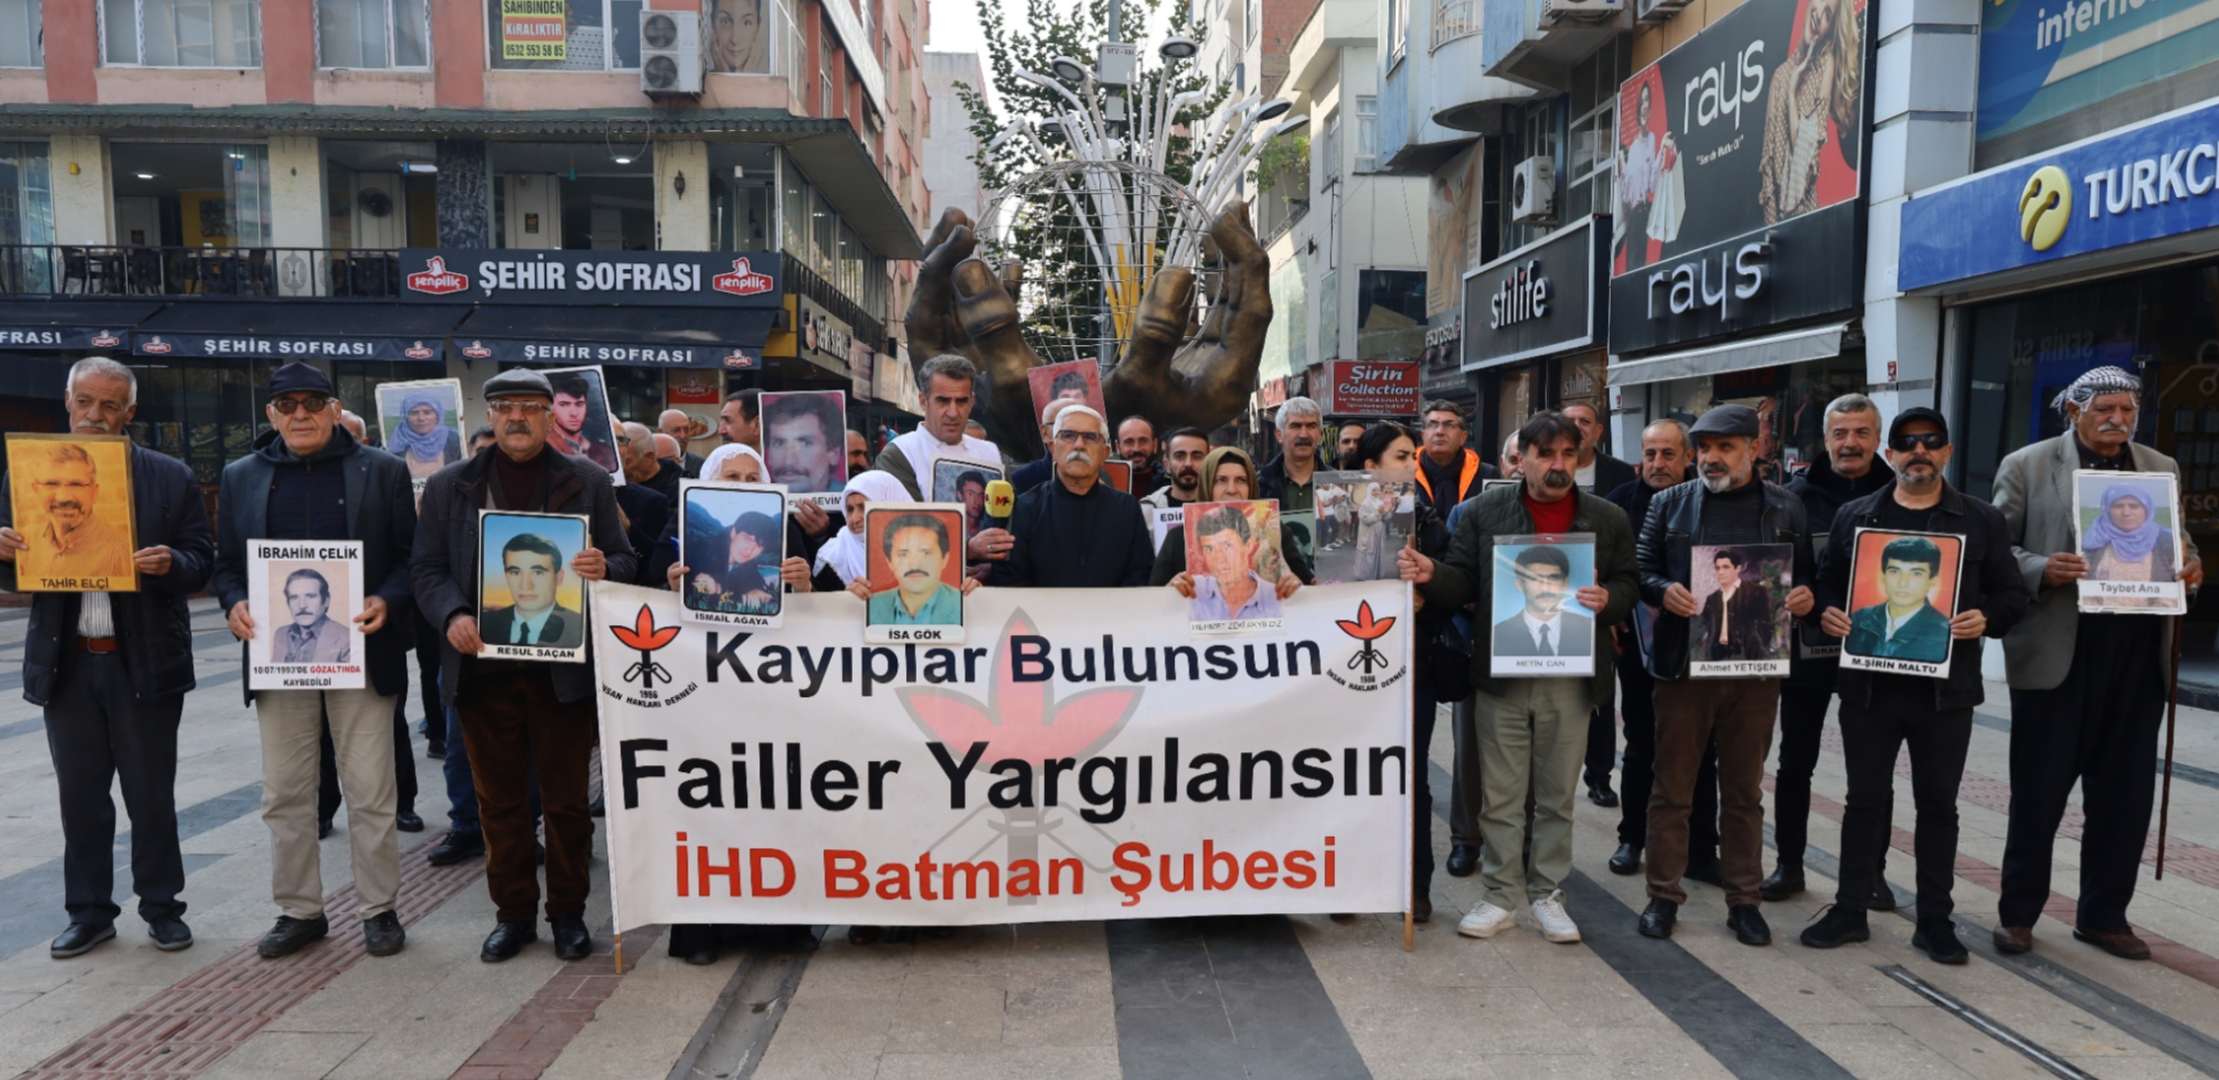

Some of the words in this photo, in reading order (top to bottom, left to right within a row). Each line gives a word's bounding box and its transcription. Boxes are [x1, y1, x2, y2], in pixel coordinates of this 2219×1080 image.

[506, 44, 524, 56] 0532
[527, 44, 540, 56] 553
[543, 45, 552, 56] 58
[554, 45, 563, 56] 85
[1684, 39, 1764, 135] rays
[2084, 141, 2219, 219] TURKC
[414, 274, 461, 291] şenpiliç
[479, 253, 566, 297] ŞEHİR
[576, 262, 701, 291] SOFRASI
[719, 275, 766, 291] şenpiliç
[1647, 242, 1763, 322] rays
[1490, 260, 1547, 330] stilife
[204, 337, 272, 355] ŞEHİR
[278, 340, 373, 355] SOFRASI
[524, 344, 590, 360] ŞEHİR
[597, 347, 693, 363] SOFRASI
[1350, 365, 1403, 384] Şirin
[1338, 382, 1414, 396] Collection
[258, 544, 315, 559] İBRAHİM
[319, 545, 359, 562] ÇELİK
[40, 577, 78, 589] TAHİR
[81, 577, 109, 590] ELÇİ
[2099, 582, 2136, 594] Taybet
[2138, 583, 2160, 594] Ana
[695, 611, 731, 623] İSMAİL
[733, 615, 769, 626] AĞAYA
[888, 628, 910, 640] İSA
[914, 628, 942, 640] GÖK
[497, 646, 533, 656] RESUL
[537, 648, 575, 659] SAÇAN
[310, 664, 362, 674] GÖZALTINDA
[705, 632, 987, 696] Kayıplar
[1011, 632, 1322, 687] Bulunsun
[1516, 658, 1543, 668] METİN
[1546, 659, 1566, 668] CAN
[1699, 663, 1732, 673] Ahmet
[1733, 660, 1778, 673] YETİŞEN
[1852, 657, 1895, 669] M.ŞİRİN
[1898, 662, 1938, 674] MALTU
[283, 676, 332, 687] KAYBEDİLDİ
[1348, 682, 1378, 692] HAKLARI
[602, 683, 622, 700] NSAN
[626, 696, 662, 708] HAKLARI
[664, 681, 698, 706] DERNEĞİ
[620, 737, 902, 811] Failler
[927, 736, 1407, 825] Yargılansın
[674, 832, 796, 897] İHD
[824, 848, 1085, 901] Batman
[1110, 836, 1337, 908] Şubesi
